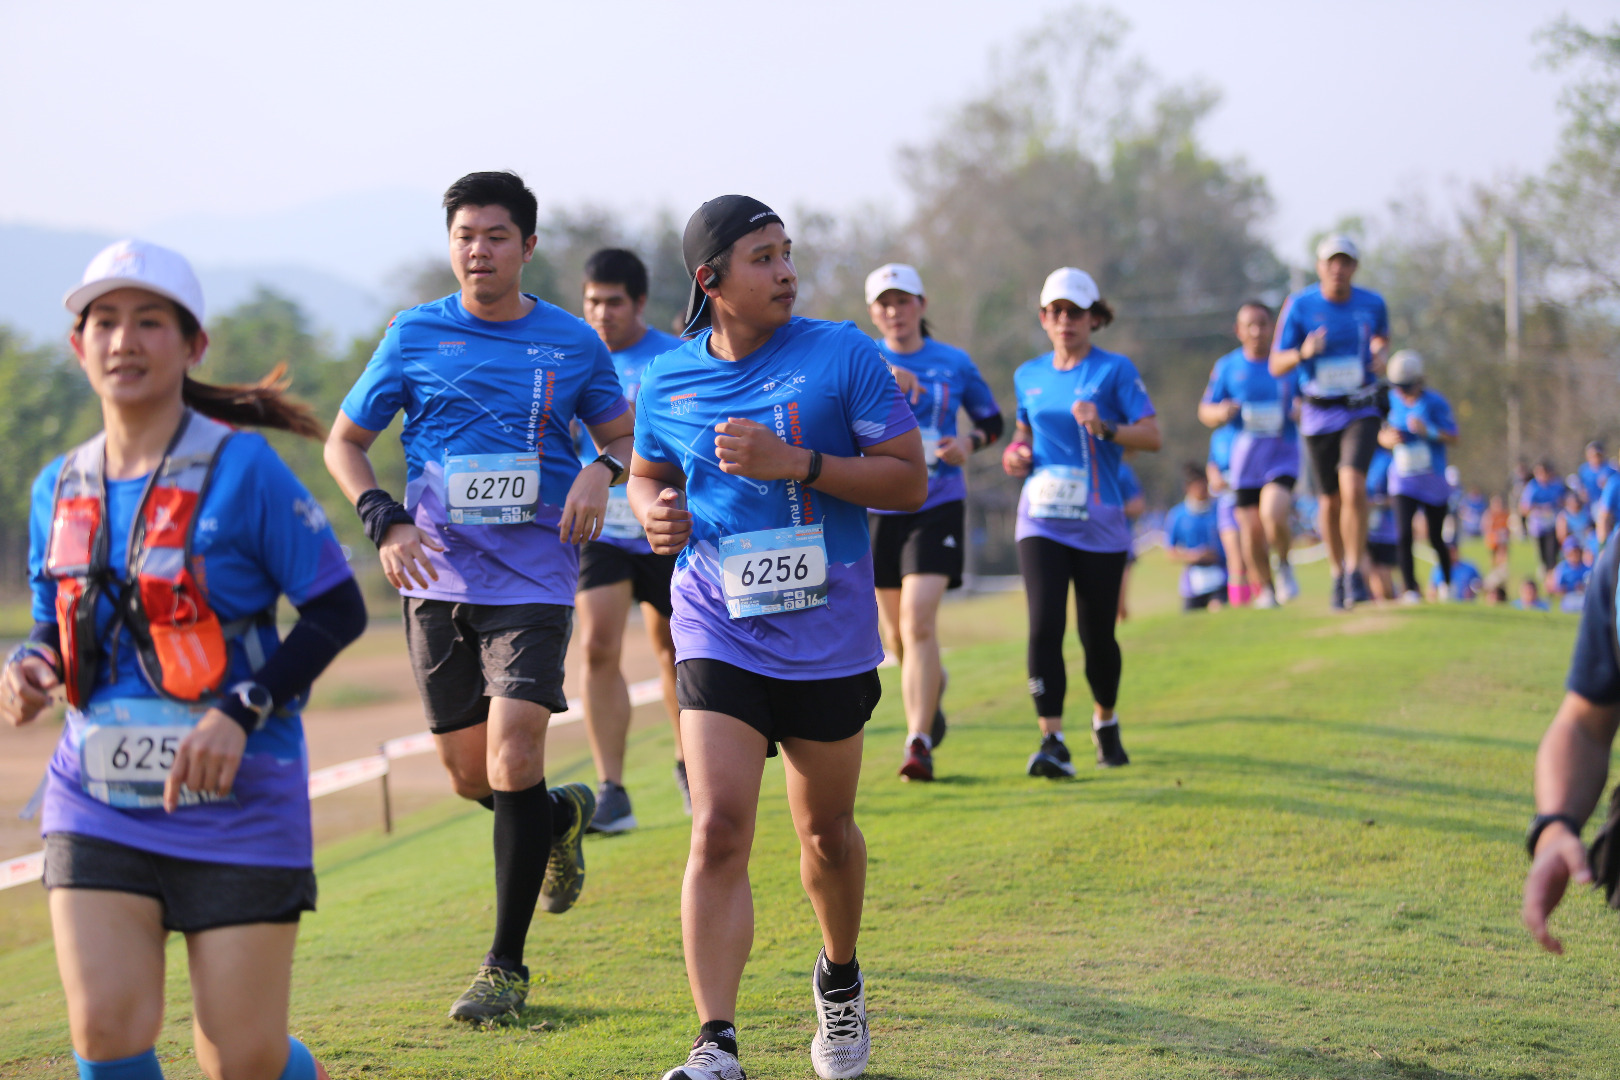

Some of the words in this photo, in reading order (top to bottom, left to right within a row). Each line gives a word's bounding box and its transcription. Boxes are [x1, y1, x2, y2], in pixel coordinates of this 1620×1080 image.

[749, 211, 767, 223] UNDER
[527, 348, 539, 356] SP
[553, 351, 566, 361] XC
[533, 368, 543, 400] CROSS
[543, 370, 556, 412] SINGHA
[763, 382, 776, 392] SP
[793, 375, 806, 385] XC
[526, 401, 540, 446] COUNTRY
[787, 402, 804, 448] SINGH
[467, 476, 525, 500] 6270
[790, 504, 801, 528] RUN
[741, 553, 808, 587] 6256
[112, 735, 179, 771] 625
